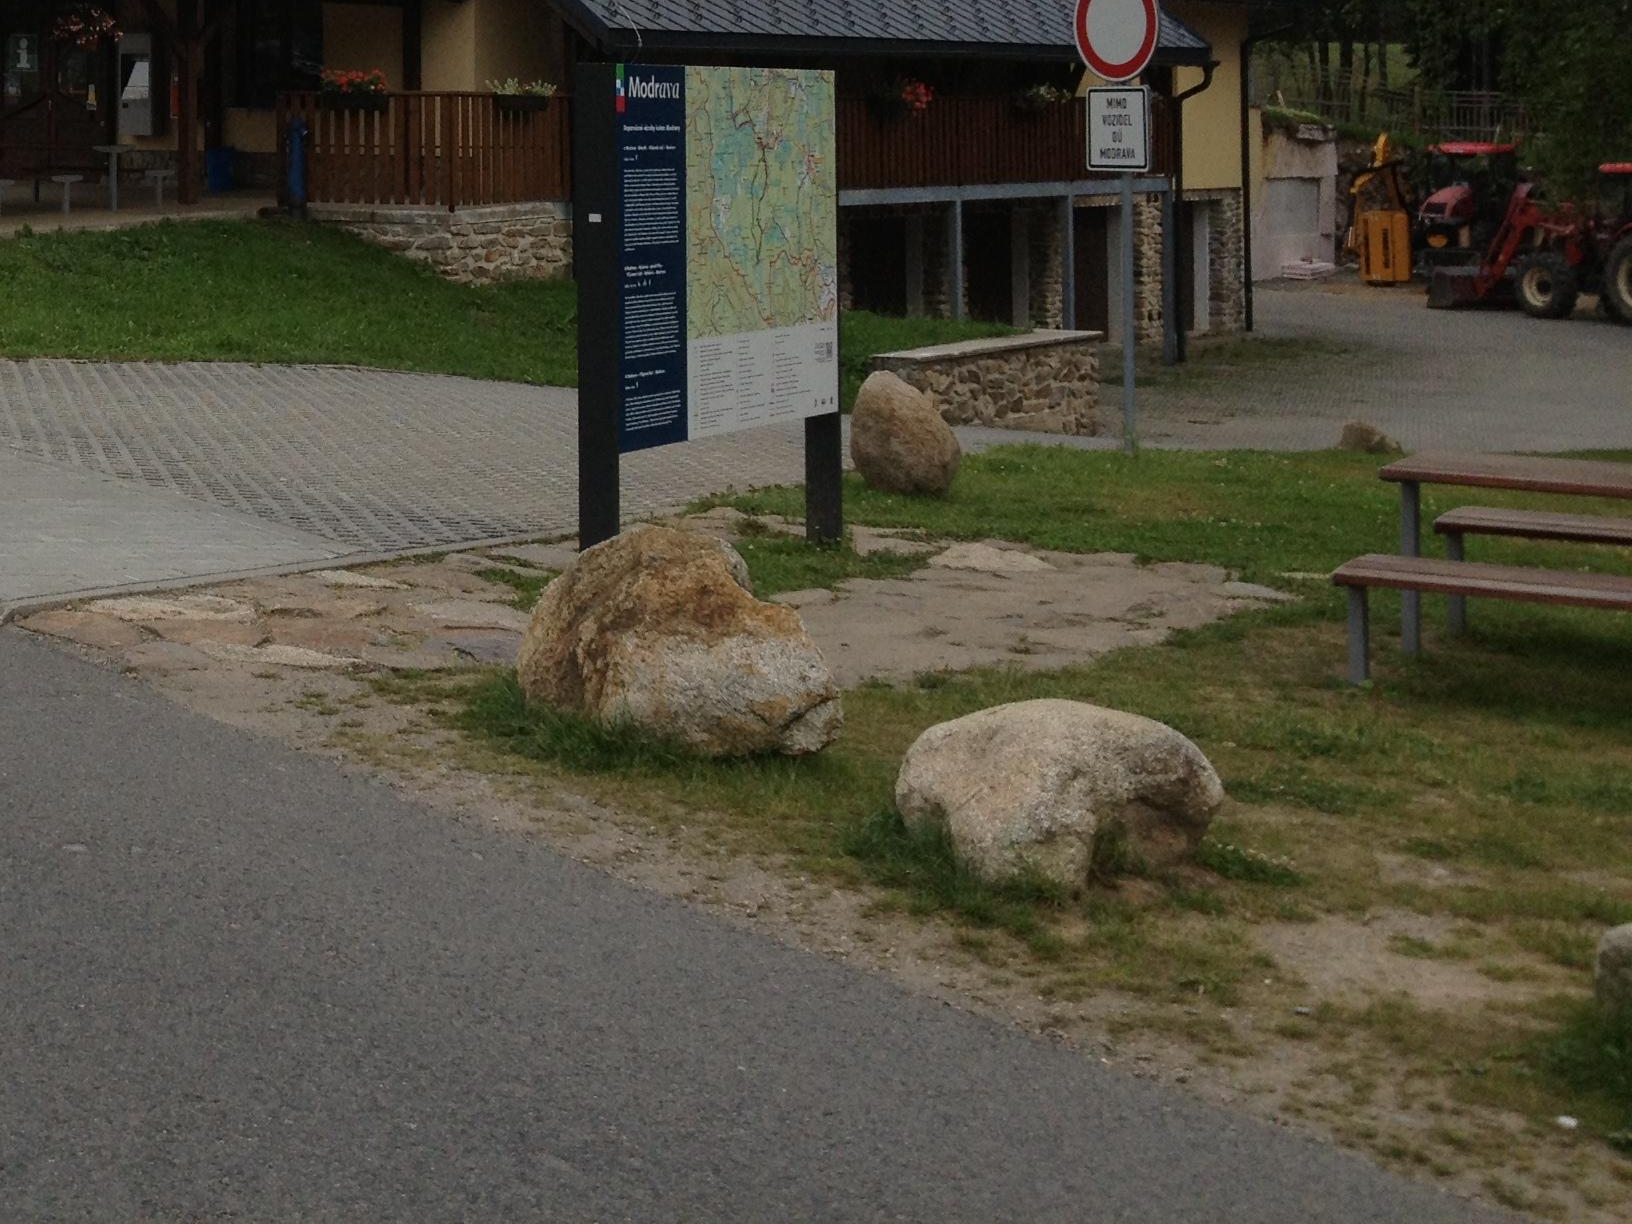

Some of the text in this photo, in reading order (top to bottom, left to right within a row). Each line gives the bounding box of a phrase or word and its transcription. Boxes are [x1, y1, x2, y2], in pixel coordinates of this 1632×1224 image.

[628, 74, 680, 99] Modrava
[1107, 97, 1127, 109] MIMO
[1102, 114, 1132, 126] VOZIDEL
[1100, 147, 1135, 159] MODRAVA
